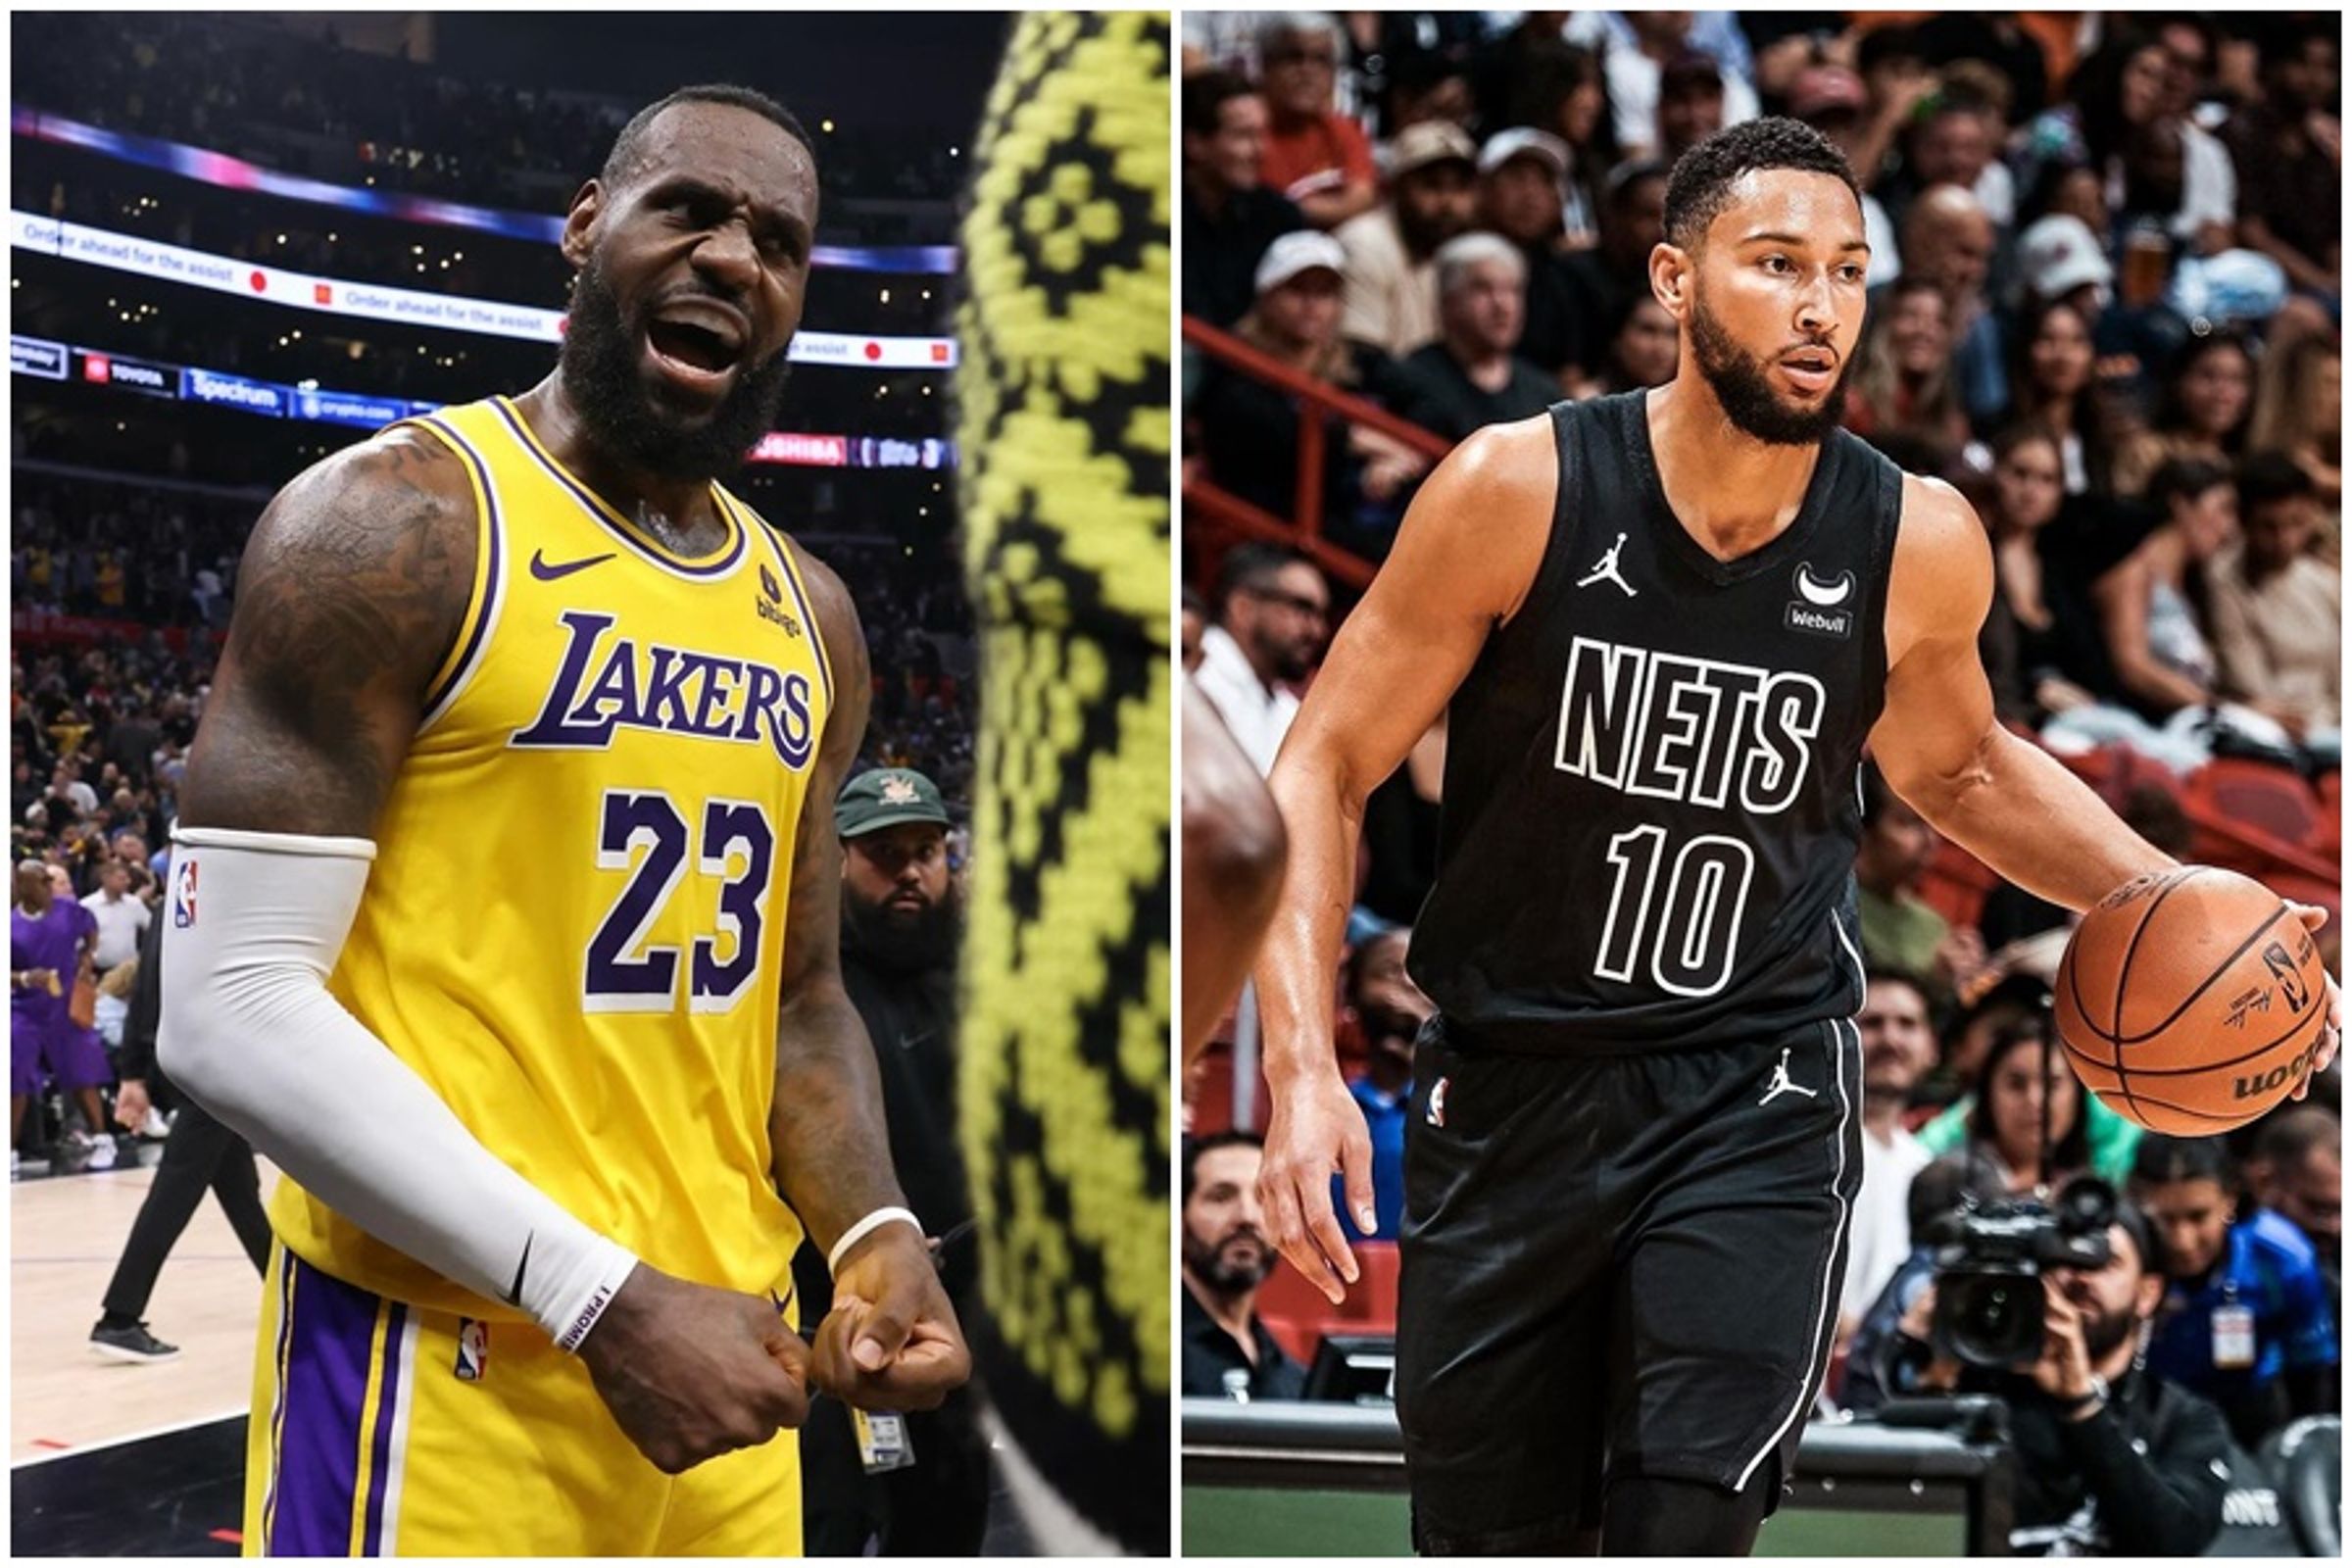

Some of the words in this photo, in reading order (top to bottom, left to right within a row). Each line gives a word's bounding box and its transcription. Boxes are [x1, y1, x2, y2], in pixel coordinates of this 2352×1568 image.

[24, 223, 75, 248] Order
[80, 238, 129, 260] ahead
[133, 247, 154, 264] for
[159, 254, 184, 270] the
[189, 263, 233, 283] assist
[346, 290, 390, 308] Order
[396, 299, 442, 318] ahead
[447, 304, 465, 319] for
[470, 308, 493, 323] the
[499, 315, 542, 331] assist
[806, 342, 848, 355] assist
[1792, 609, 1845, 633] Webull
[1554, 635, 1827, 814] NETS
[581, 787, 776, 1014] 23
[1593, 823, 1754, 998] 10
